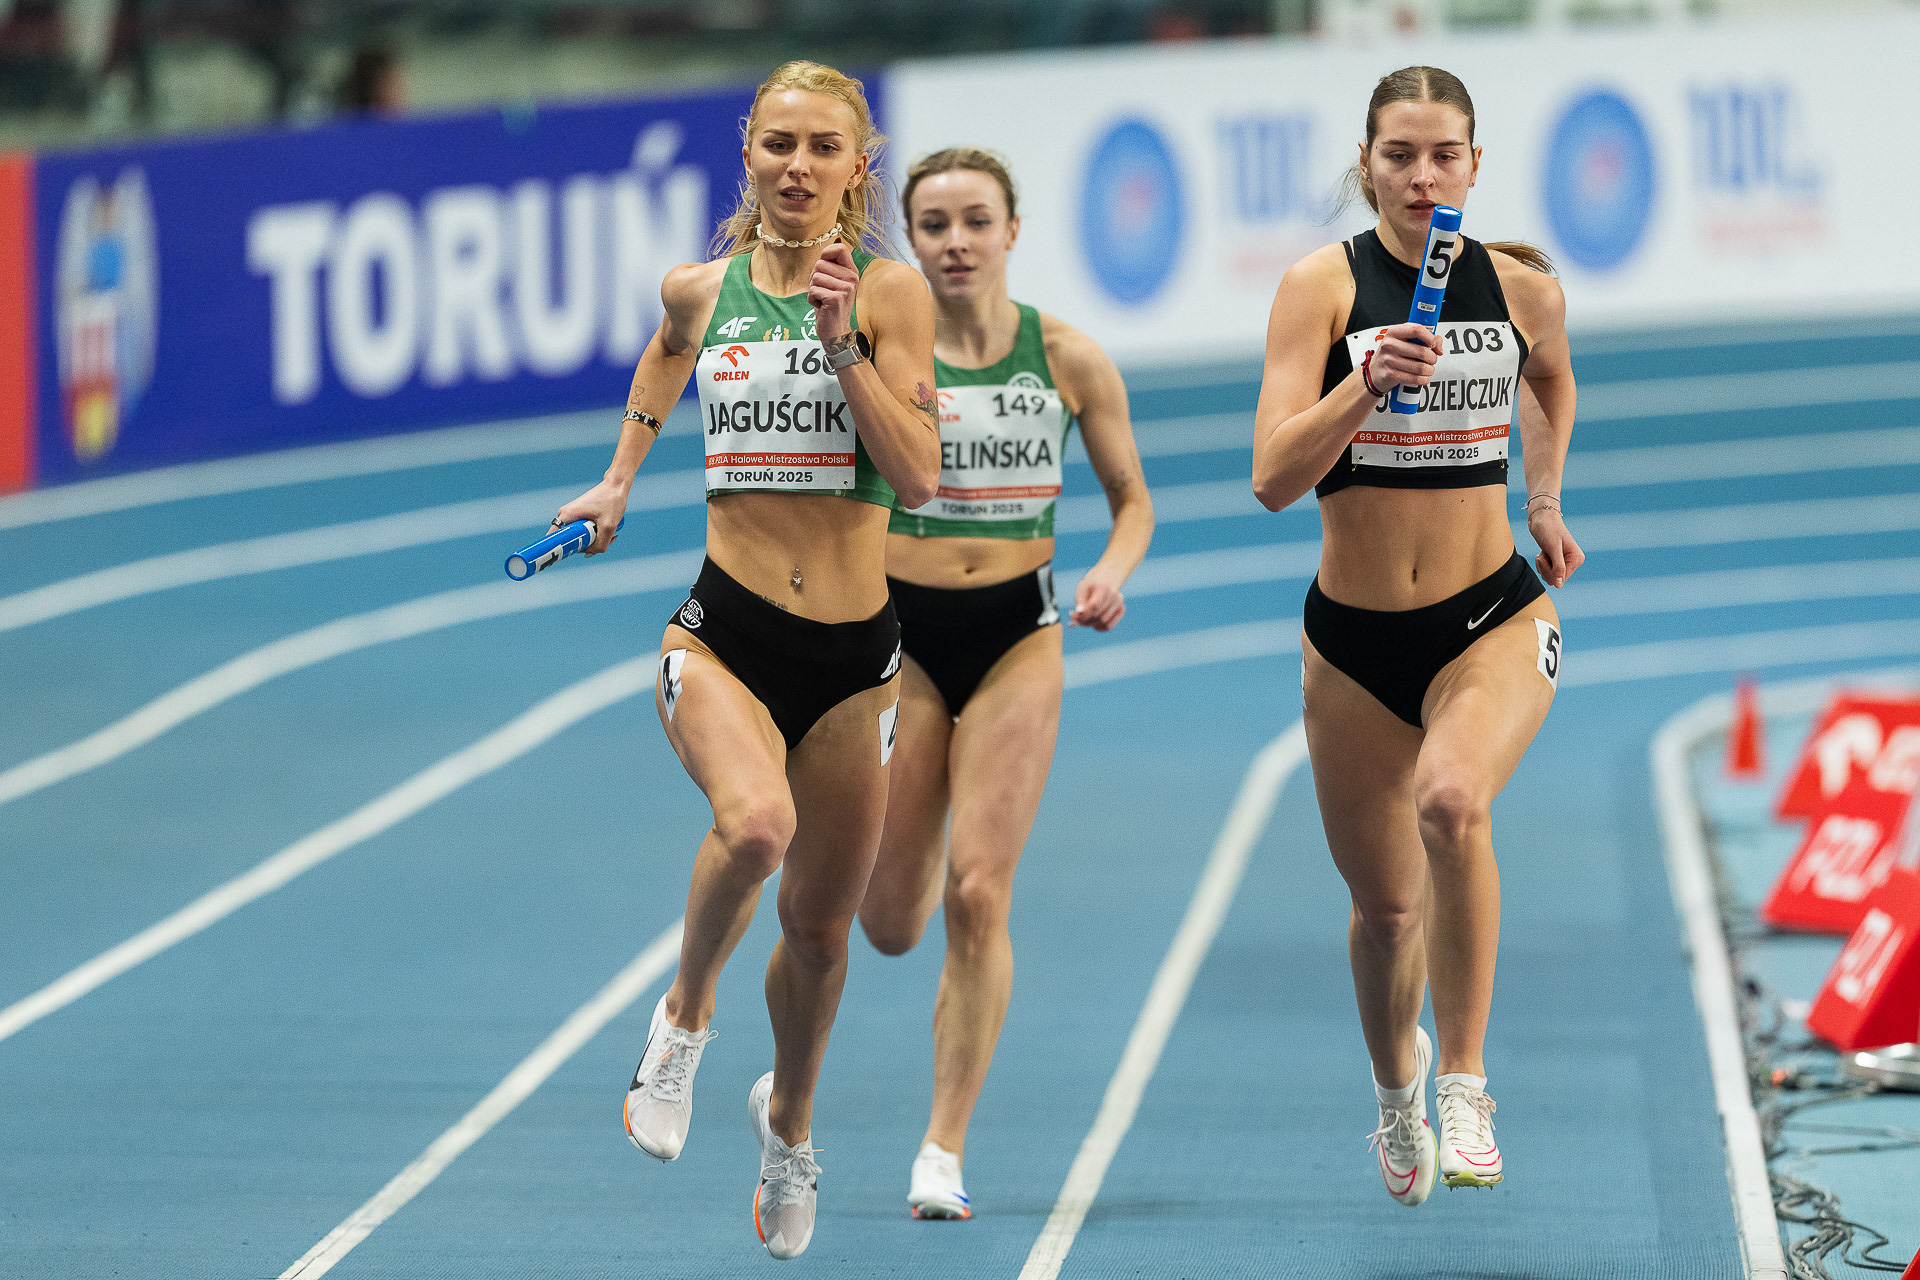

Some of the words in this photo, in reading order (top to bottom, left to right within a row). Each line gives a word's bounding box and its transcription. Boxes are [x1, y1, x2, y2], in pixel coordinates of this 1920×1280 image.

[246, 121, 708, 404] TORUŃ
[1427, 240, 1455, 279] 5
[717, 317, 758, 338] 4F
[1445, 328, 1503, 354] 103
[713, 371, 749, 381] ORLEN
[993, 393, 1046, 417] 149
[1375, 376, 1512, 413] DZIEJCZUK
[709, 394, 848, 435] JAGUŚCIK
[1359, 433, 1374, 441] 69.
[1376, 434, 1398, 442] PZLA
[1400, 434, 1433, 443] Halowe
[1435, 431, 1483, 441] Mistrzostwa
[1484, 426, 1505, 437] Polski
[731, 455, 763, 463] Halowe
[765, 455, 820, 464] Mistrzostwa
[822, 455, 849, 463] Polski
[941, 434, 1052, 469] ELIŃSKA
[1394, 446, 1443, 462] TORUŃ
[1448, 446, 1479, 459] 2025
[725, 468, 773, 482] TORUŃ
[777, 471, 813, 482] 2025
[1545, 627, 1559, 679] 5
